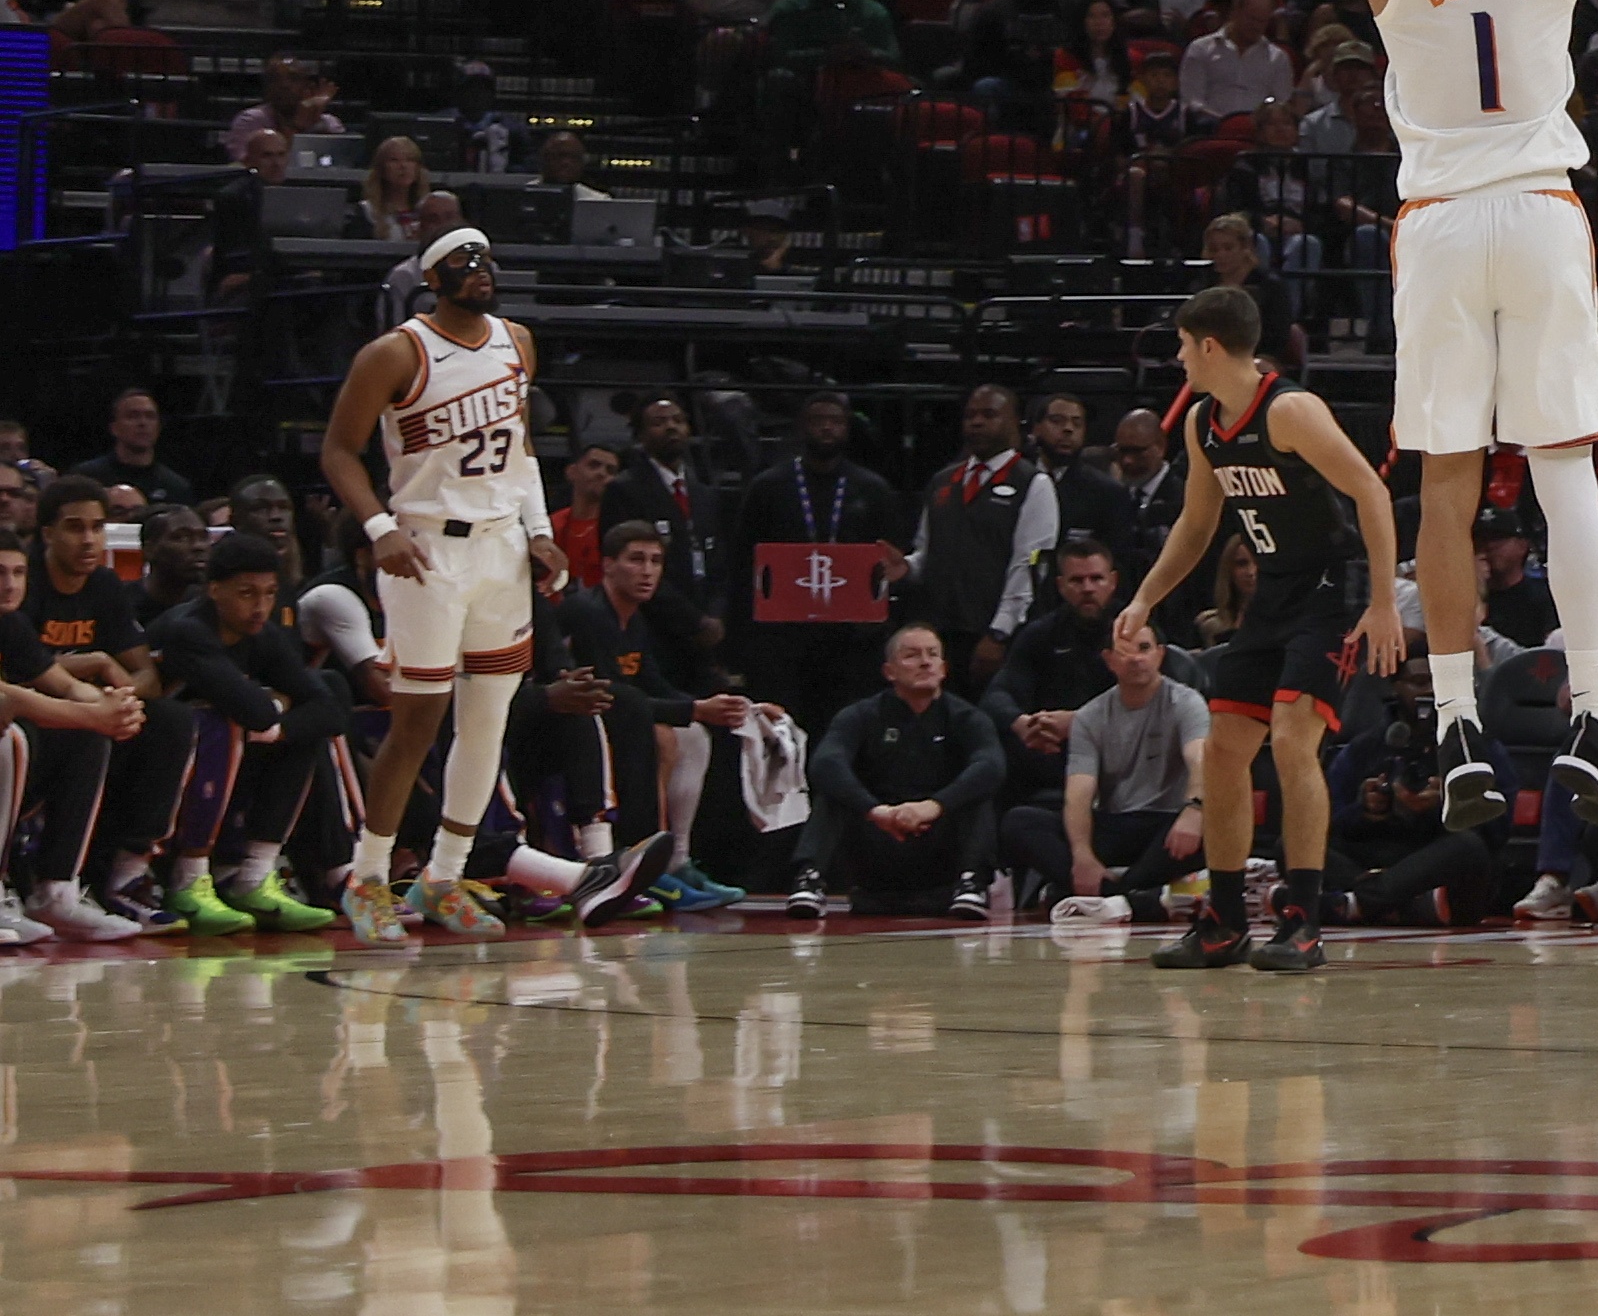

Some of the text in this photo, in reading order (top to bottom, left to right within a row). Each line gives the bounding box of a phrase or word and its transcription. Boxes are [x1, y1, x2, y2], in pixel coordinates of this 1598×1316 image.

[1469, 10, 1507, 114] 1
[460, 429, 512, 477] 23
[1237, 507, 1278, 554] 15
